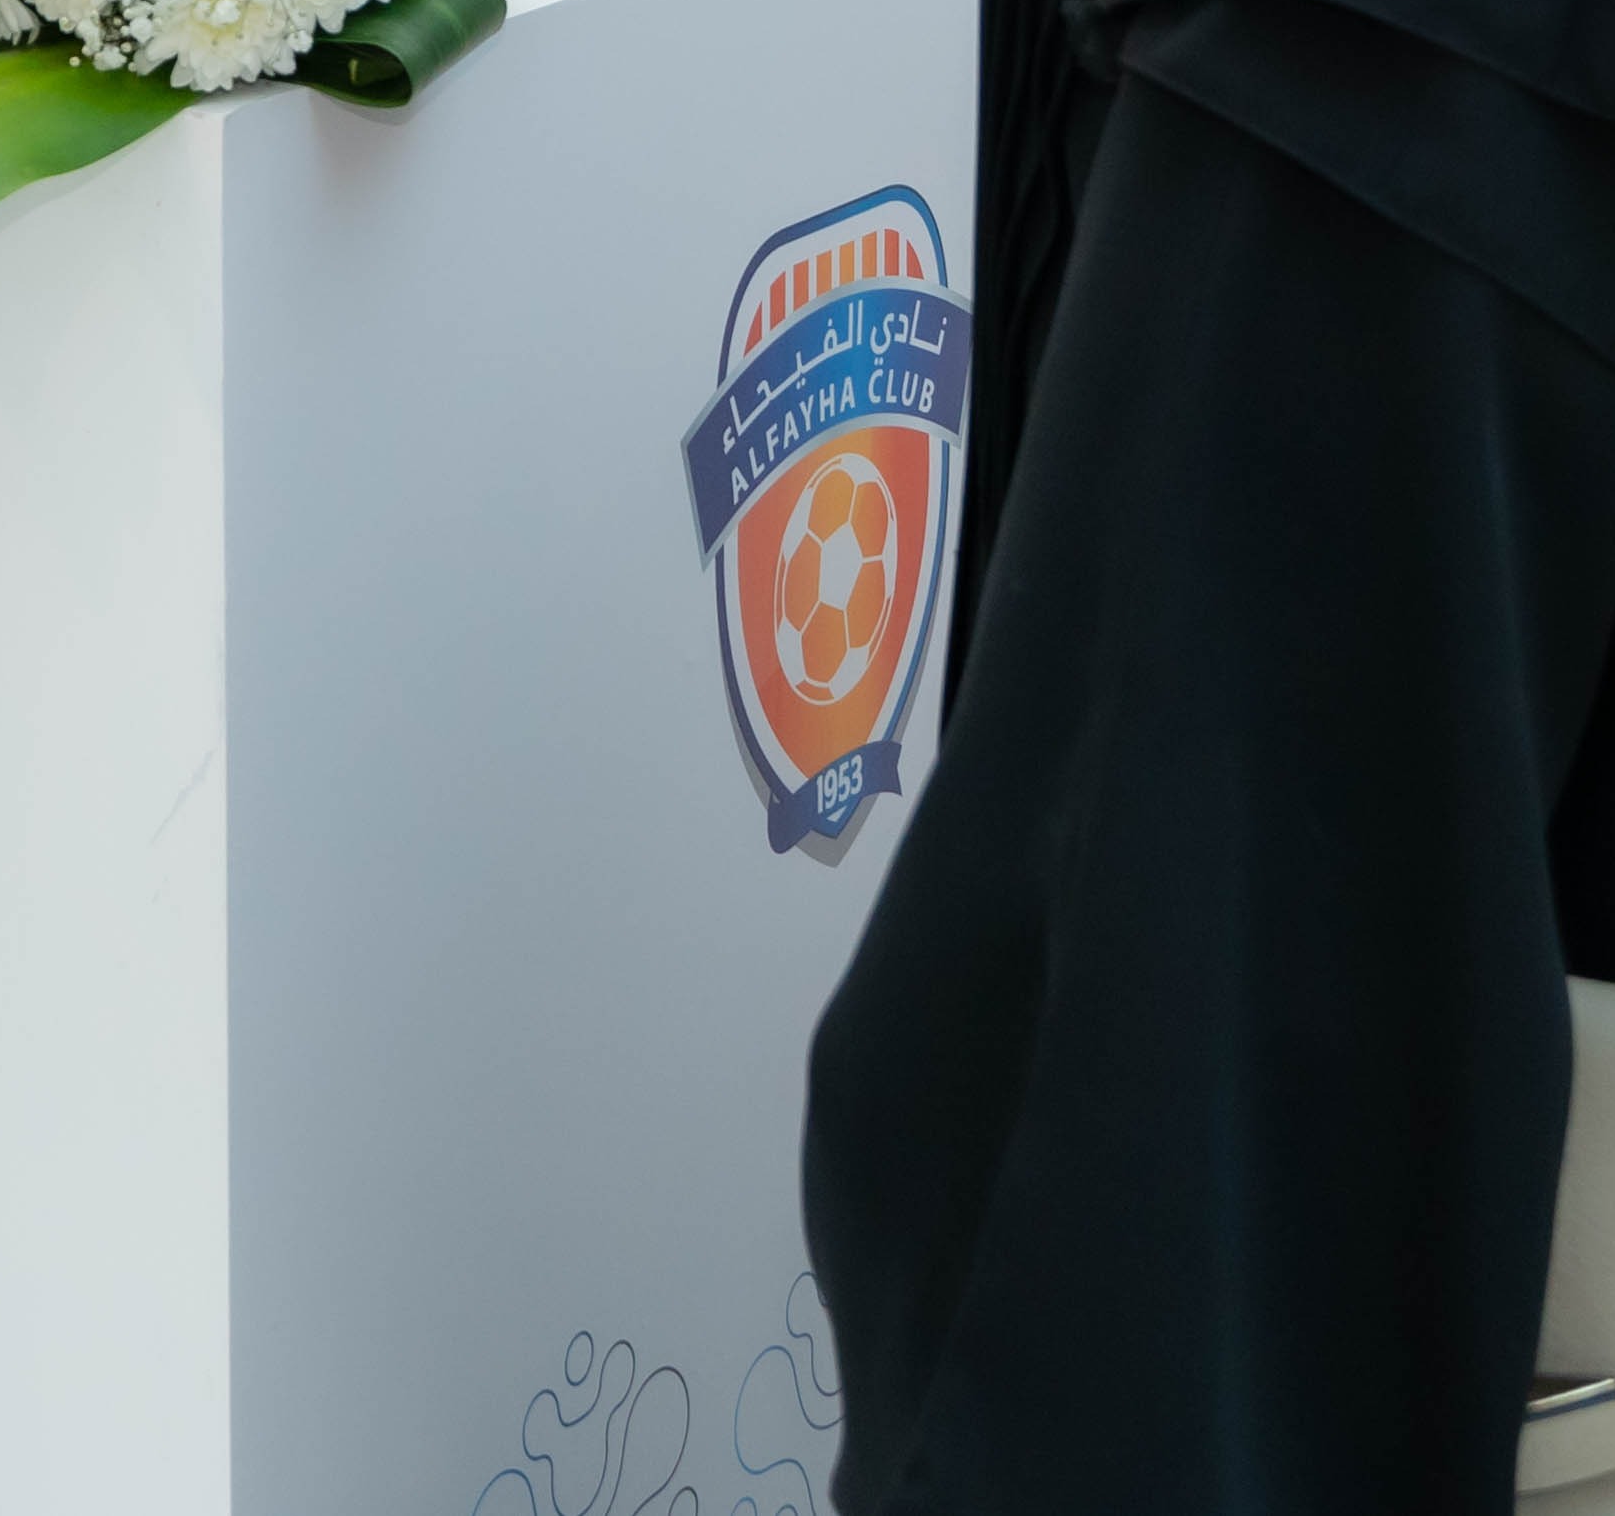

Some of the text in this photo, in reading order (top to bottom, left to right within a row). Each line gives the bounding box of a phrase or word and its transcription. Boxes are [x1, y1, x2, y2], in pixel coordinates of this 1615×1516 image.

[722, 299, 947, 455] نادي الفيحاء
[730, 368, 936, 506] ALFAYHA CLUB
[815, 753, 863, 815] 1953
